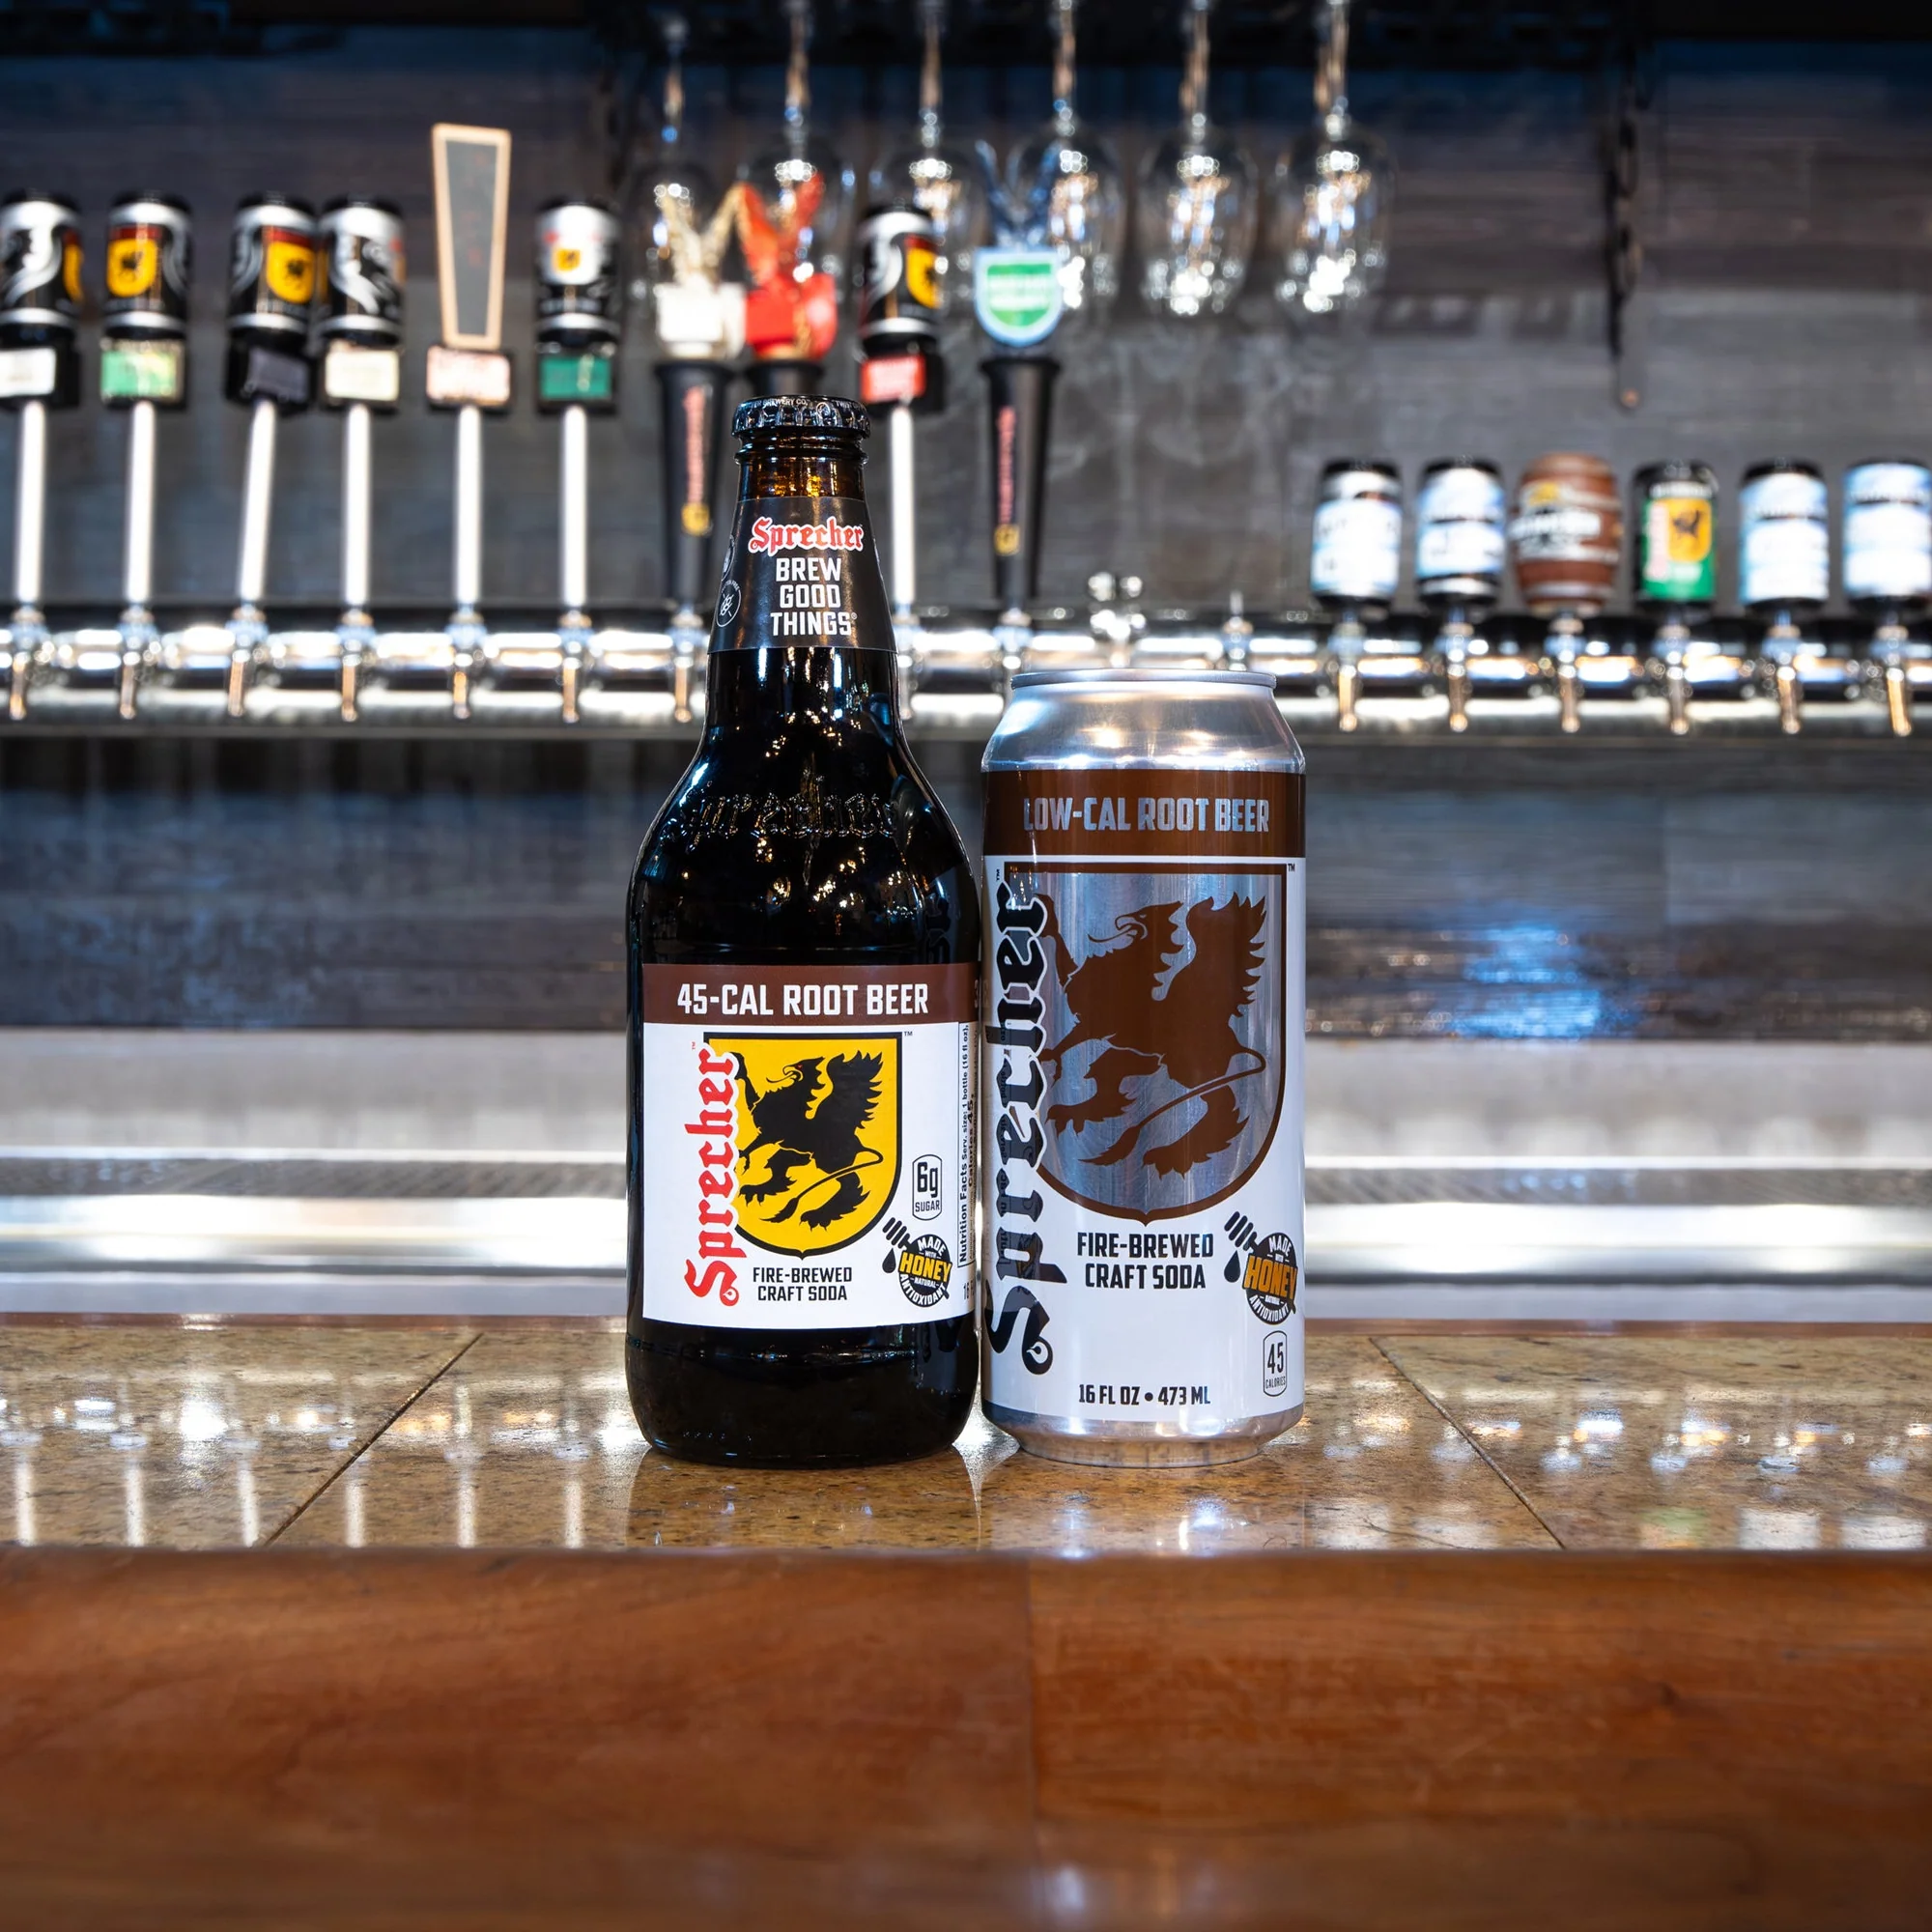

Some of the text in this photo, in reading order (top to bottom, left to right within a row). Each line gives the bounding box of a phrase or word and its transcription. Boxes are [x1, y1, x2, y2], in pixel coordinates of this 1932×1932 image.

[749, 517, 864, 554] Sprecher
[776, 557, 841, 582] BREW
[780, 584, 841, 609] GOOD
[770, 611, 852, 636] THINGS
[1023, 797, 1269, 832] LOW-CAL ROOT BEER
[677, 983, 929, 1016] 45-CAL ROOT BEER
[984, 882, 1067, 1375] Sprecher
[684, 1048, 748, 1307] Sprecher
[917, 1161, 938, 1198] 6g
[915, 1200, 940, 1212] SUGAR
[917, 1236, 946, 1257] MADE
[1077, 1233, 1214, 1258] FIRE-BREWED
[1268, 1235, 1293, 1257] MADE
[753, 1266, 853, 1283] FIRE-BREWED
[899, 1251, 952, 1283] HONEY
[1085, 1264, 1206, 1290] CRAFT SODA
[1243, 1255, 1297, 1300] HONEY
[757, 1285, 848, 1302] CRAFT SODA
[900, 1274, 948, 1306] ANTIOXIDANT
[1266, 1342, 1284, 1374] 45
[1078, 1384, 1210, 1406] 16 FL OZ 473 ML
[1264, 1376, 1286, 1390] CALORIES
